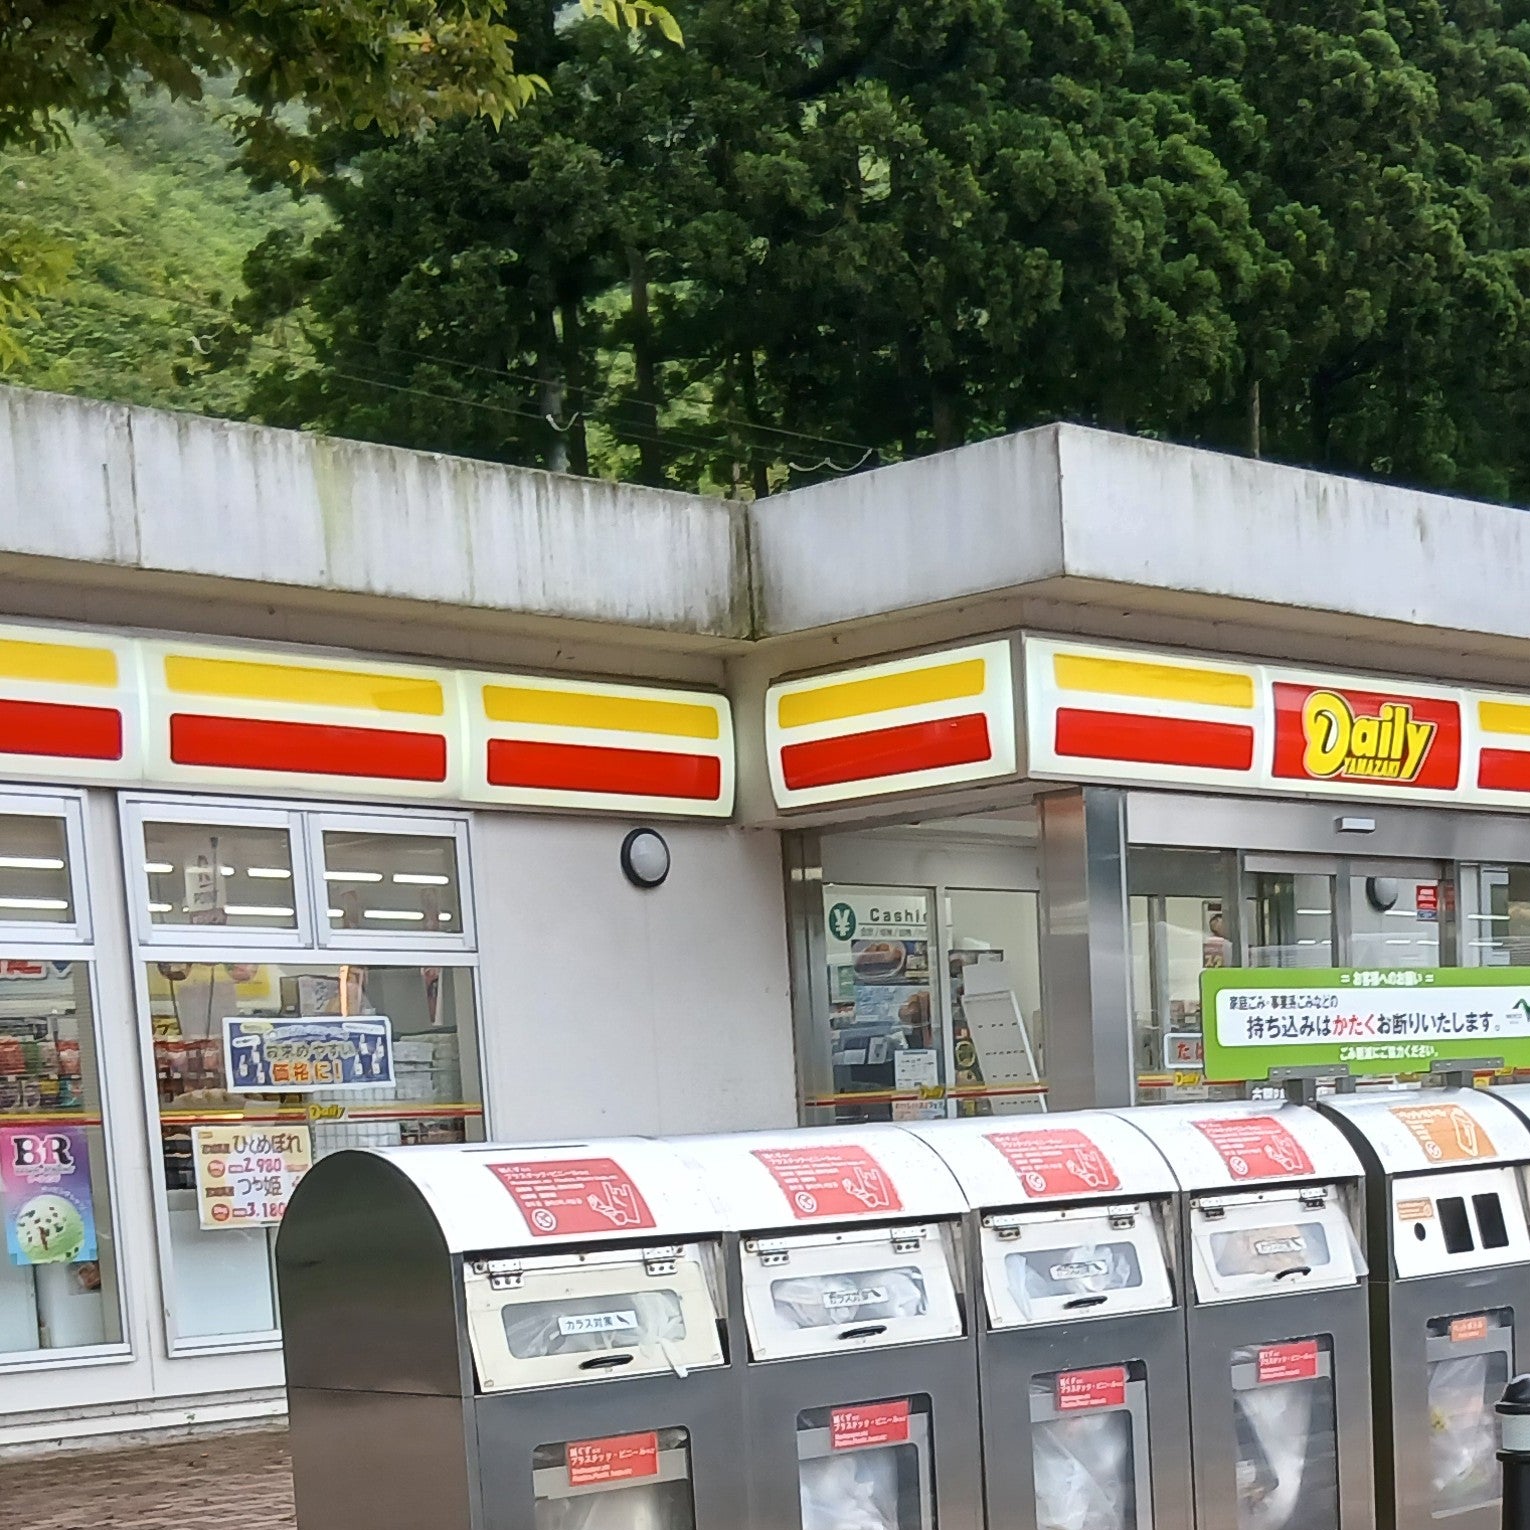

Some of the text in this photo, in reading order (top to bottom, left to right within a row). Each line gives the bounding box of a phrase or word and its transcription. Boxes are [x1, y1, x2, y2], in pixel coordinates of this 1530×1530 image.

[1302, 691, 1434, 780] Daily
[1344, 757, 1401, 778] YAMAZAKI
[1246, 1012, 1501, 1040] 持ち込みはかたくお断りいたします。
[13, 1136, 72, 1166] BR
[232, 1133, 303, 1154] ひとめぼれ
